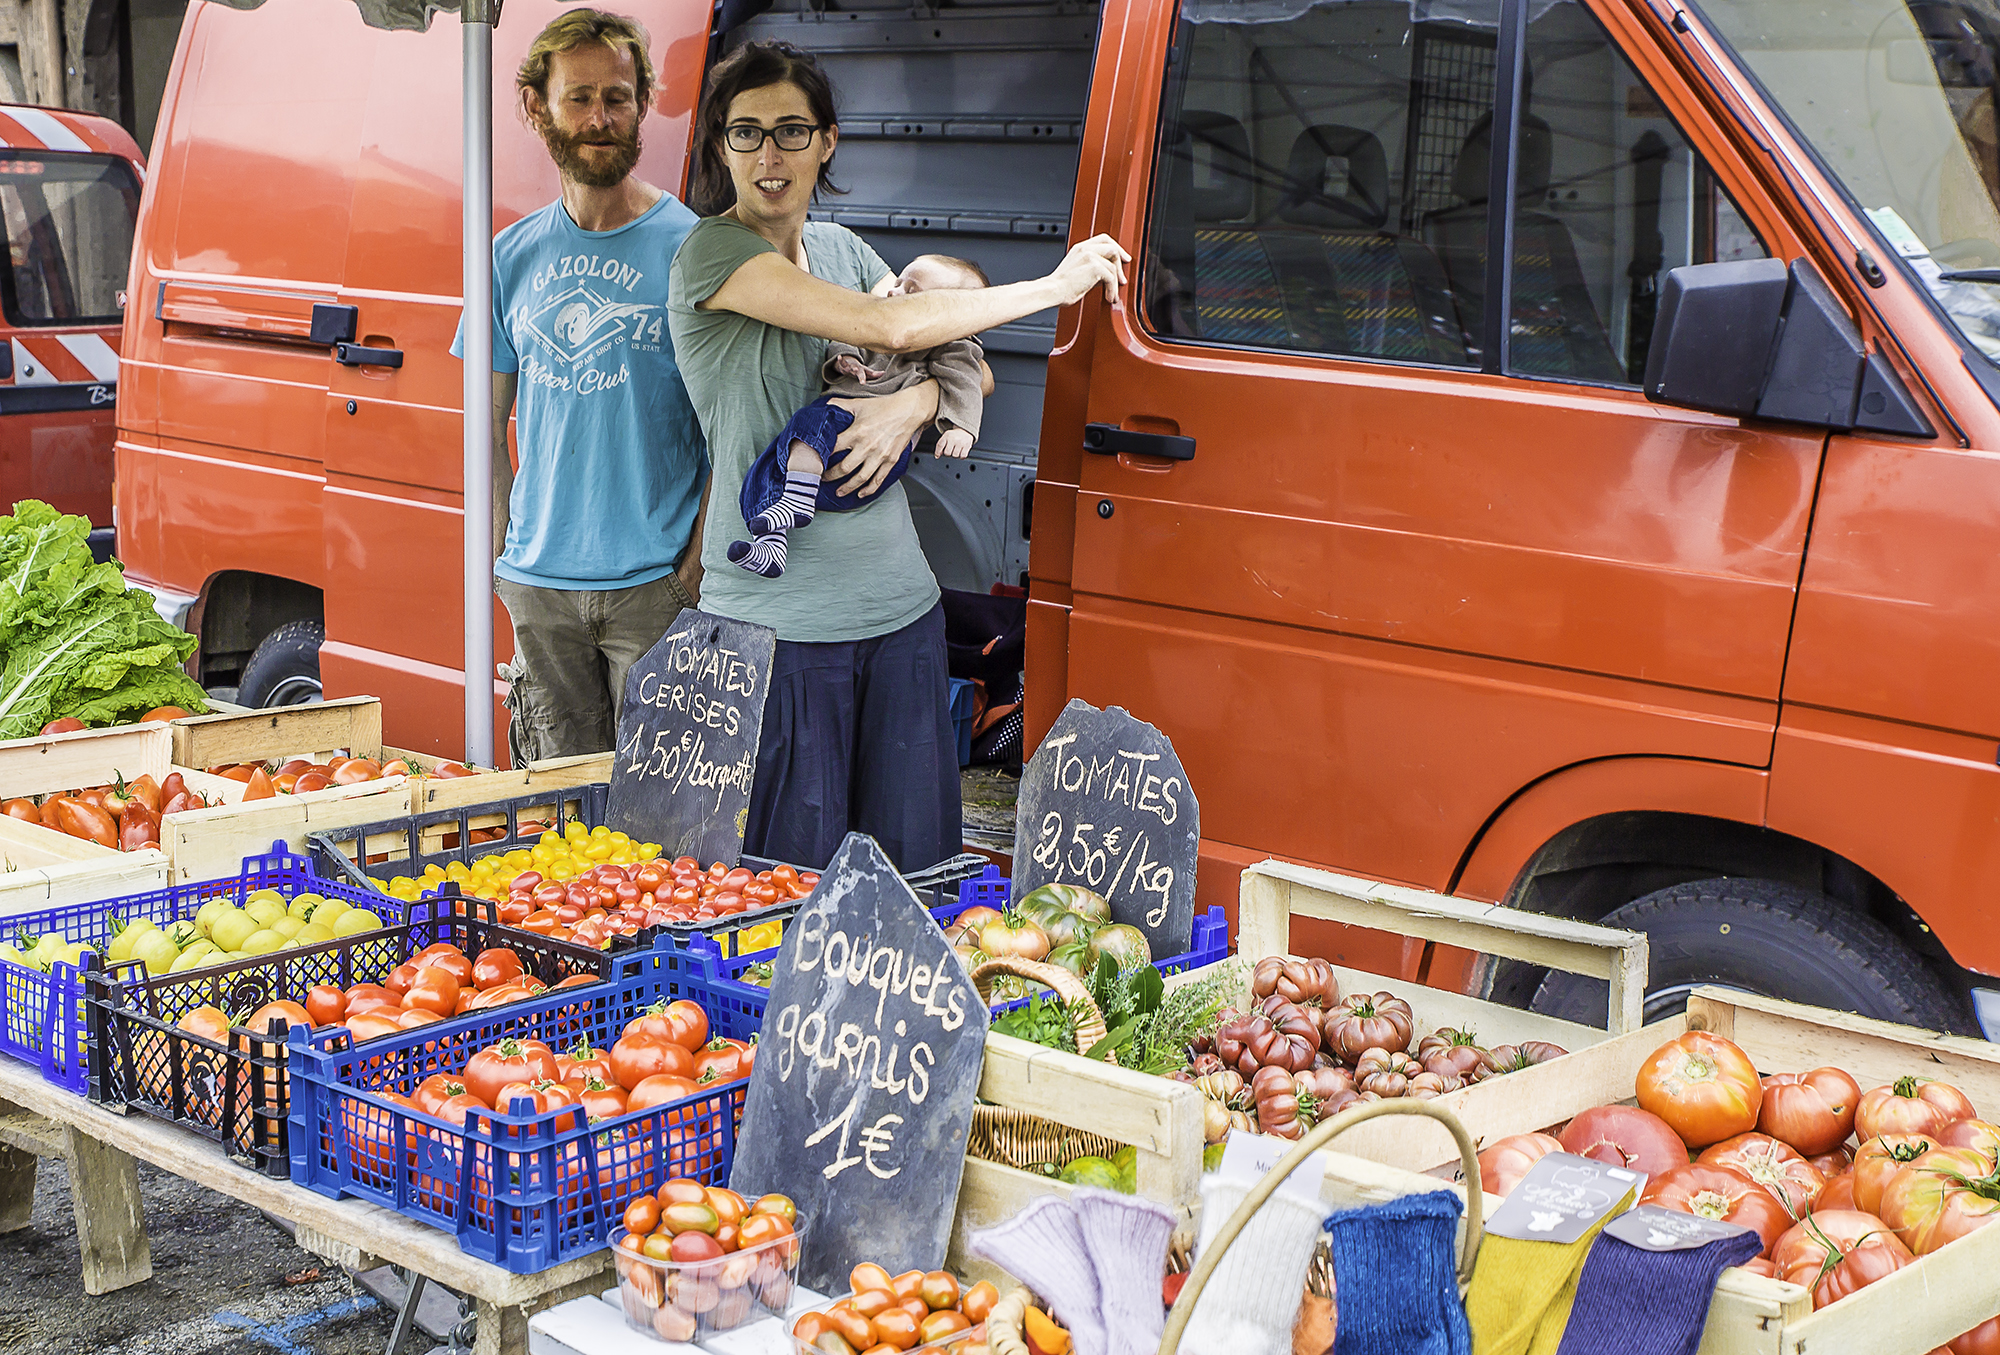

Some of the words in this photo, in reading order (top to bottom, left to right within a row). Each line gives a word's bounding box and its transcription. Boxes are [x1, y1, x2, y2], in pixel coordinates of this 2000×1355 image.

[533, 254, 643, 292] GAZOLONI
[572, 353, 595, 373] REPAIR
[595, 341, 613, 357] SHOP
[614, 335, 626, 345] CO.
[632, 312, 663, 343] 74
[519, 354, 573, 392] Motor
[577, 363, 630, 395] Club
[666, 631, 758, 698] TOMATES
[639, 672, 742, 736] CERISES
[1046, 733, 1182, 825] TOMATES
[792, 908, 967, 1032] Bouquets
[804, 1097, 905, 1180] 1€
